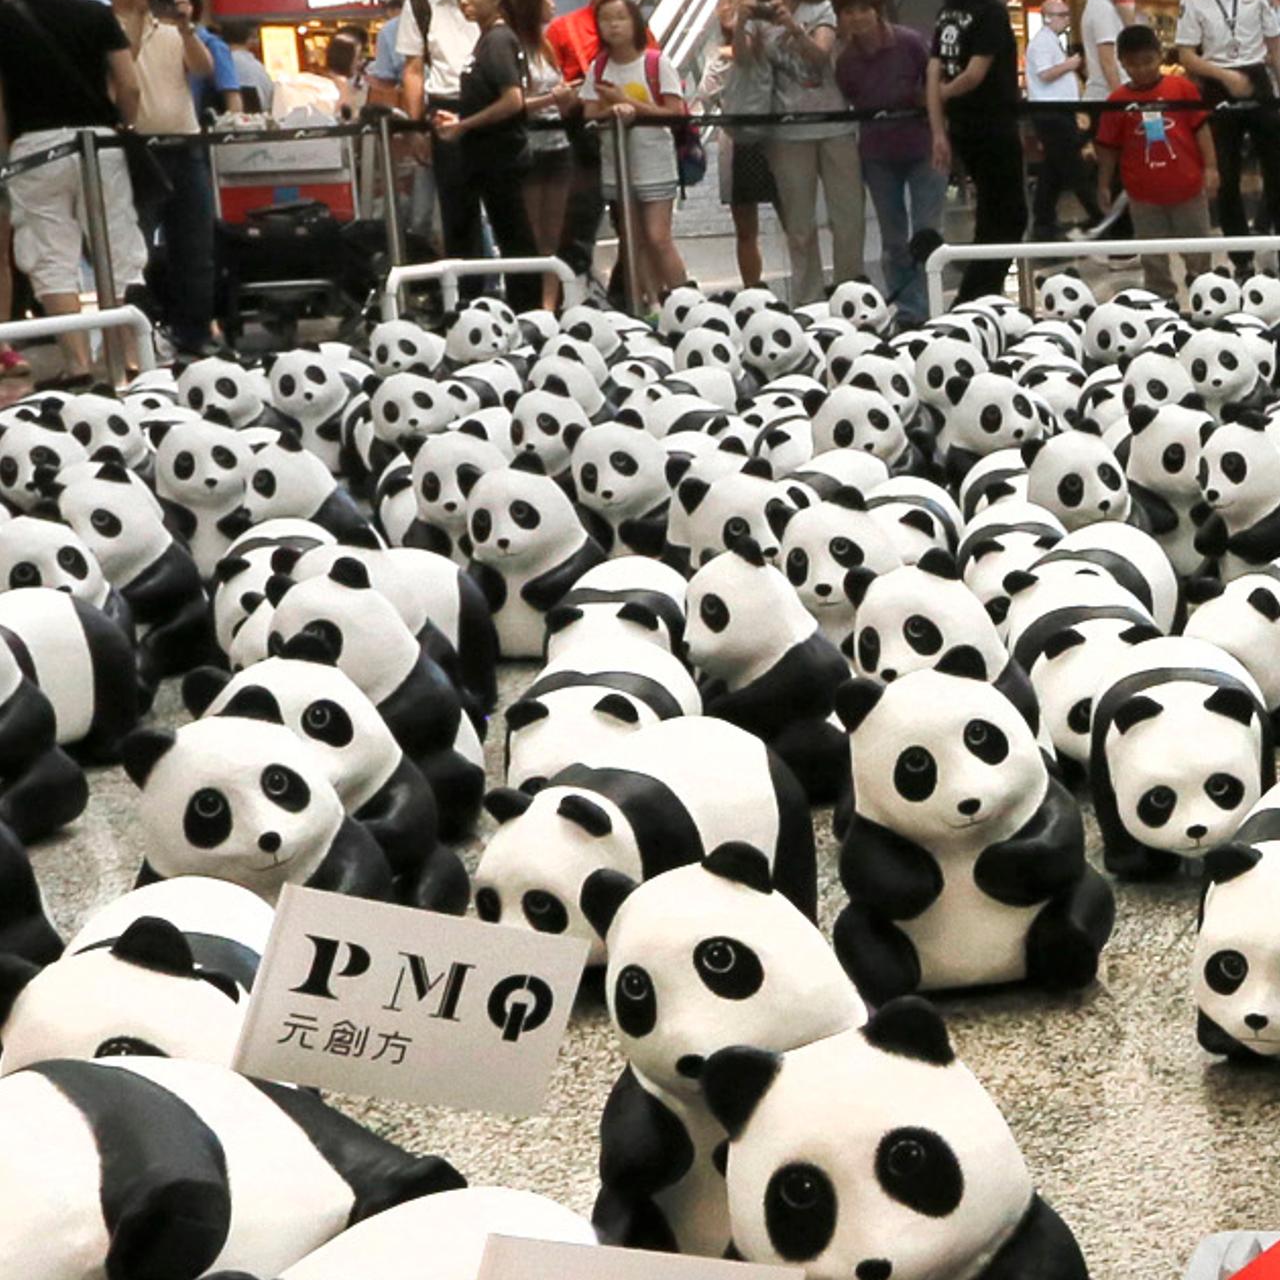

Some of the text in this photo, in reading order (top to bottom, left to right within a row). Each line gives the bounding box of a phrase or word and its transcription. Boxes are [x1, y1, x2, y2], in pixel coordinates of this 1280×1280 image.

[288, 933, 554, 1042] PMQ
[277, 1011, 412, 1065] 元創方
